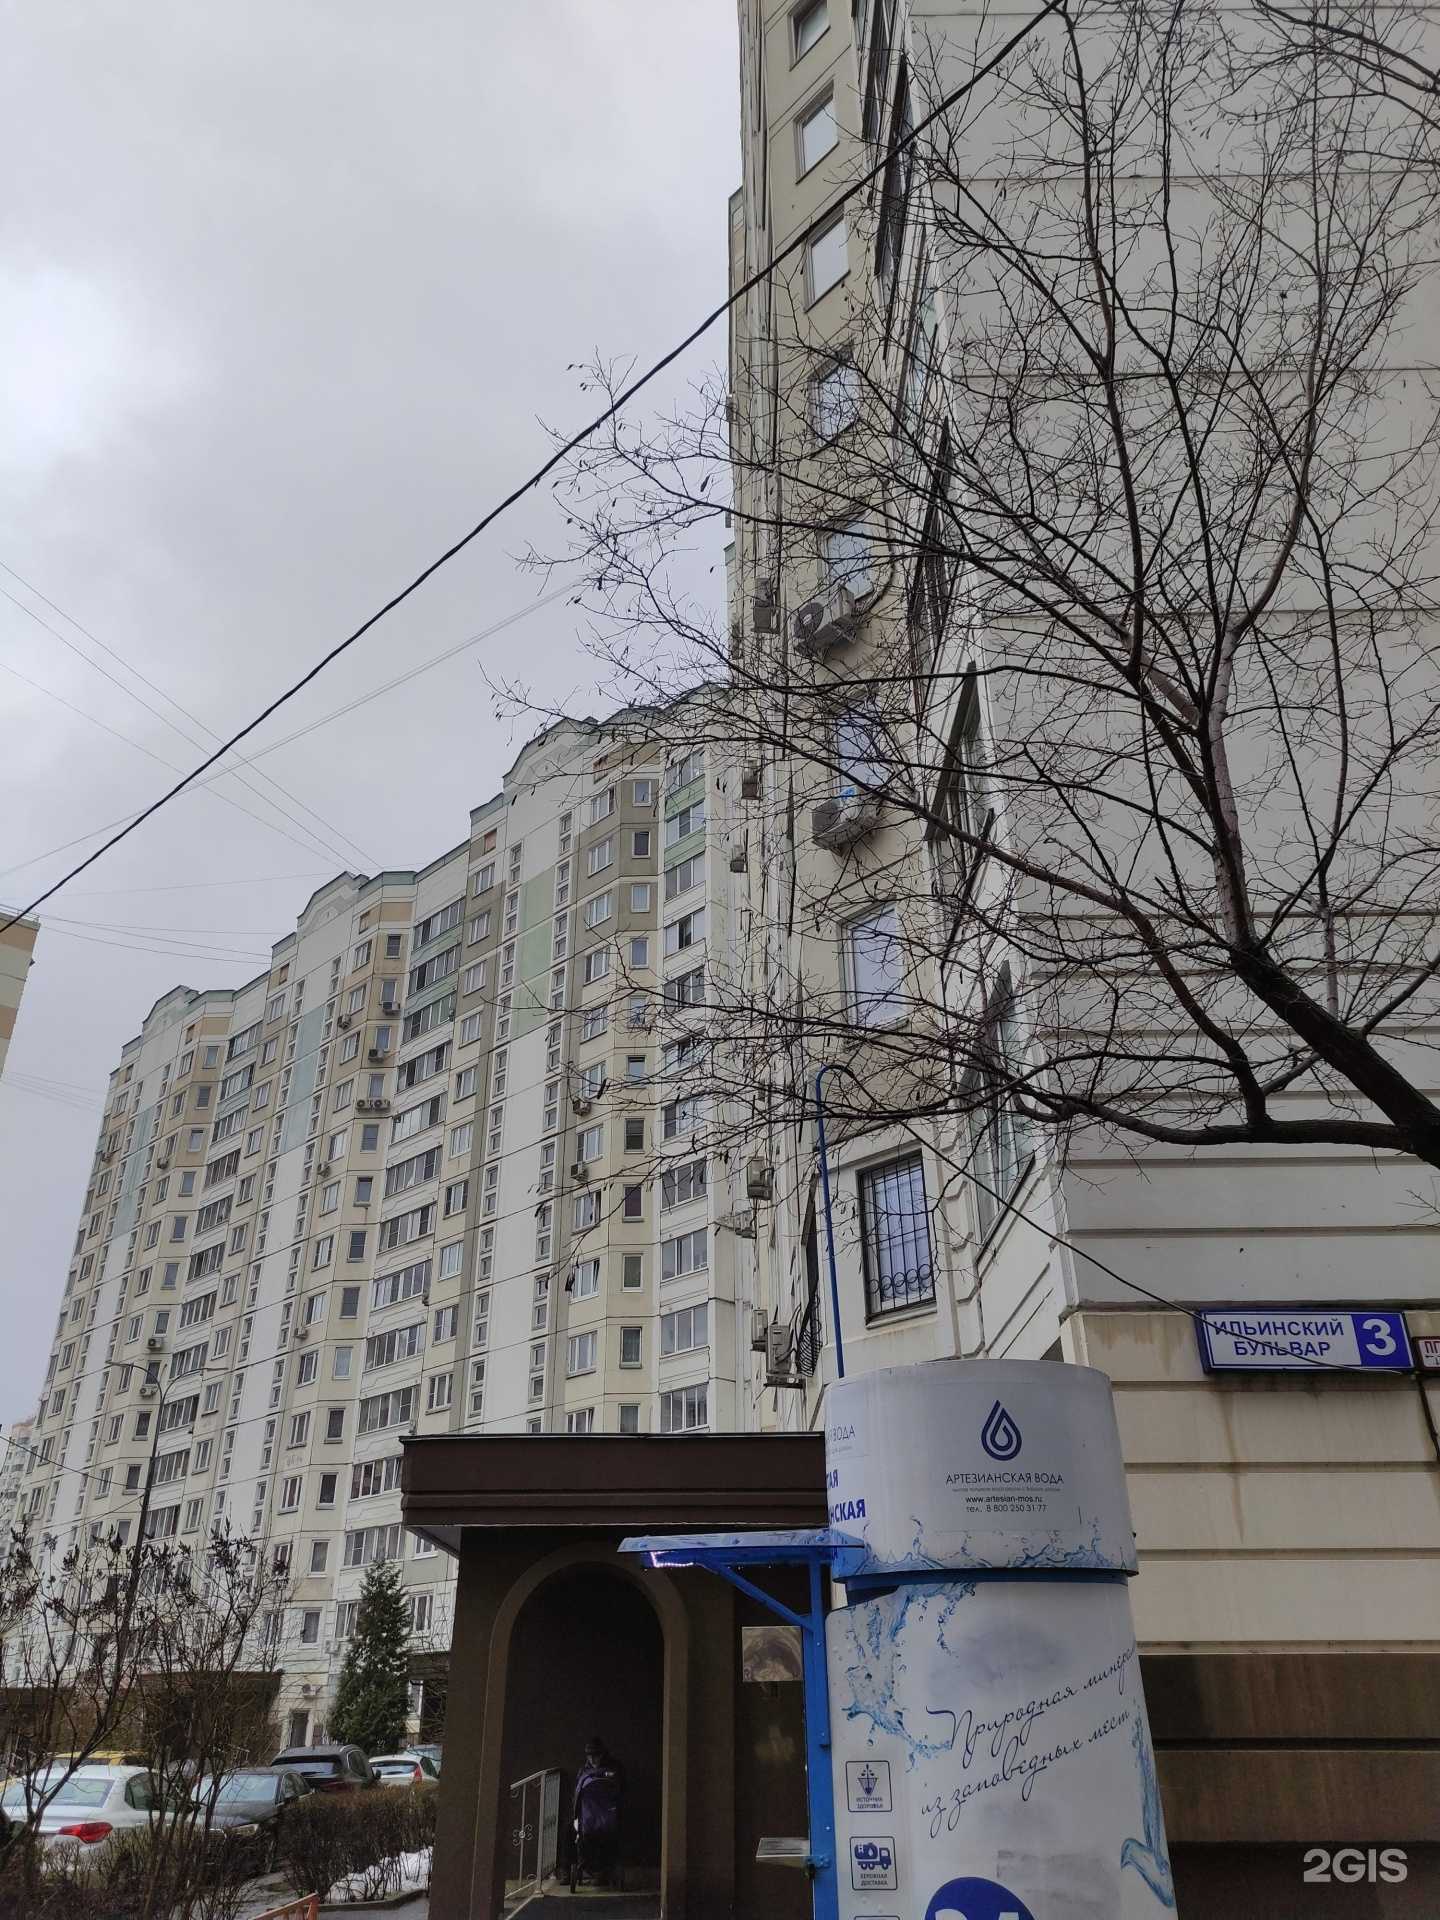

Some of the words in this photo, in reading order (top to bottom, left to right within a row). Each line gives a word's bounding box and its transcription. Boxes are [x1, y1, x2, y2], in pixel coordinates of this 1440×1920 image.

[1213, 1317, 1345, 1336] ИЛЬИНСКИЙ
[1363, 1318, 1397, 1356] 3
[1234, 1341, 1331, 1357] БУЛЬВАР
[946, 1473, 1032, 1485] АРТЕЗИАНСКАЯ
[1034, 1473, 1064, 1484] ВОДА
[926, 1687, 1078, 1769] Природная
